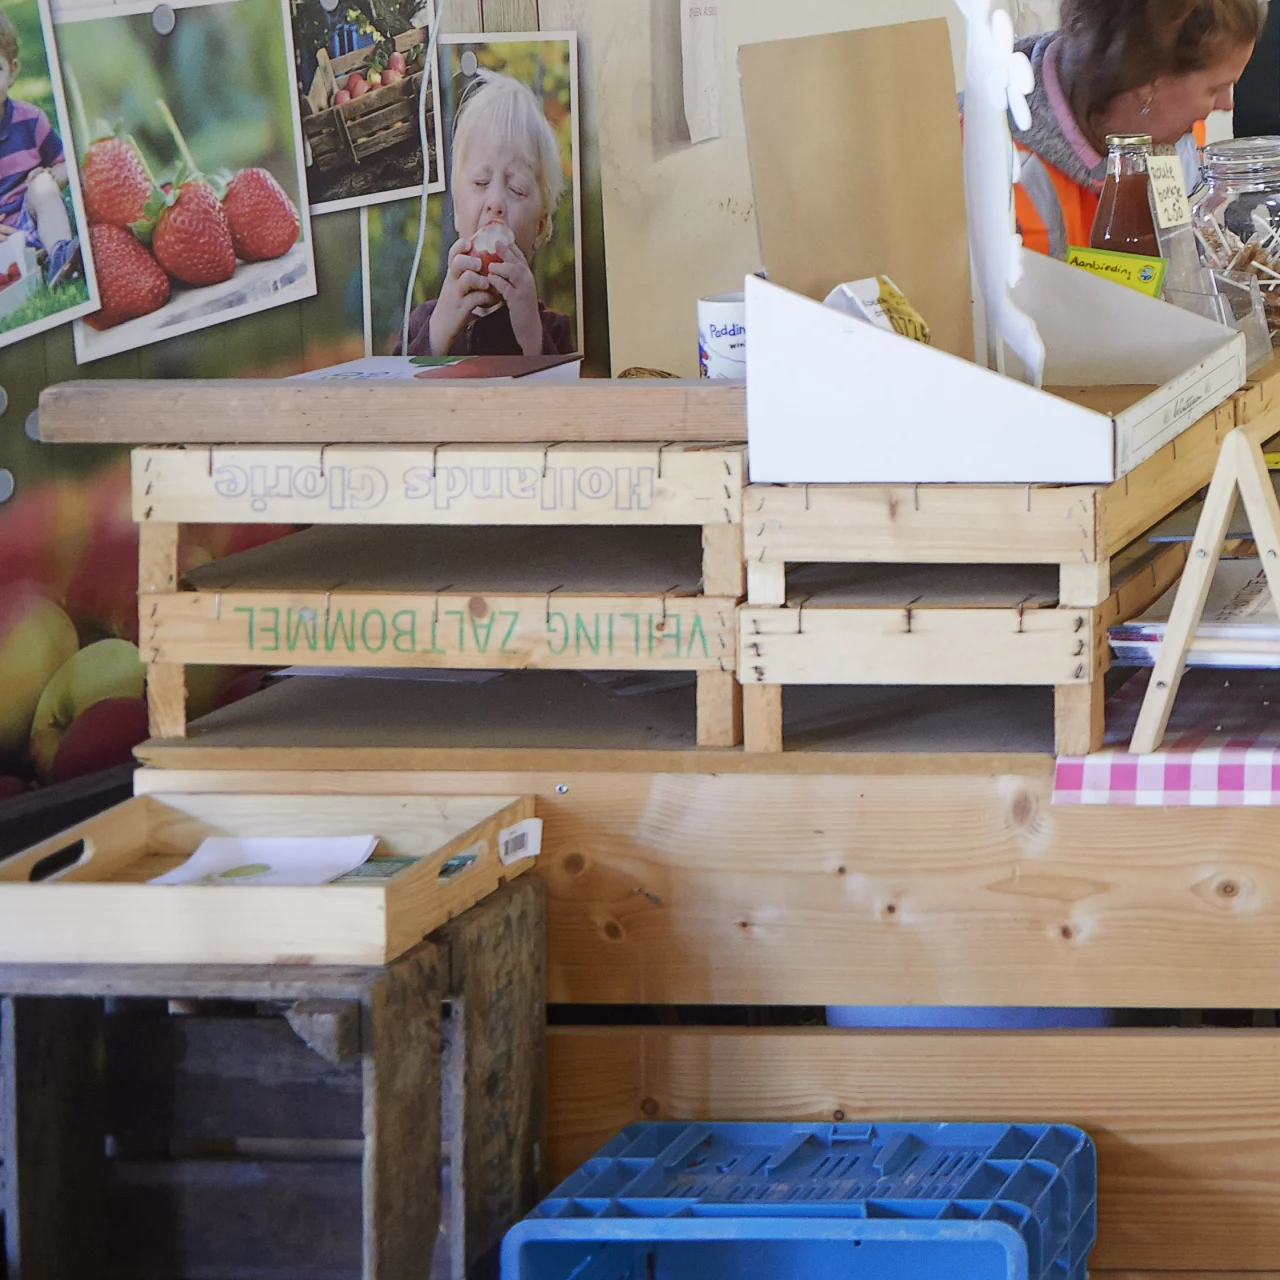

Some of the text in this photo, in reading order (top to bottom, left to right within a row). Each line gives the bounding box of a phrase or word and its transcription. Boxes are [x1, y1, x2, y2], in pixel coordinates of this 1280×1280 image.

[1069, 255, 1132, 281] Aanbieding
[213, 465, 655, 512] Hollands Glorie
[233, 605, 711, 659] VEILING ZALTBOMMEL
